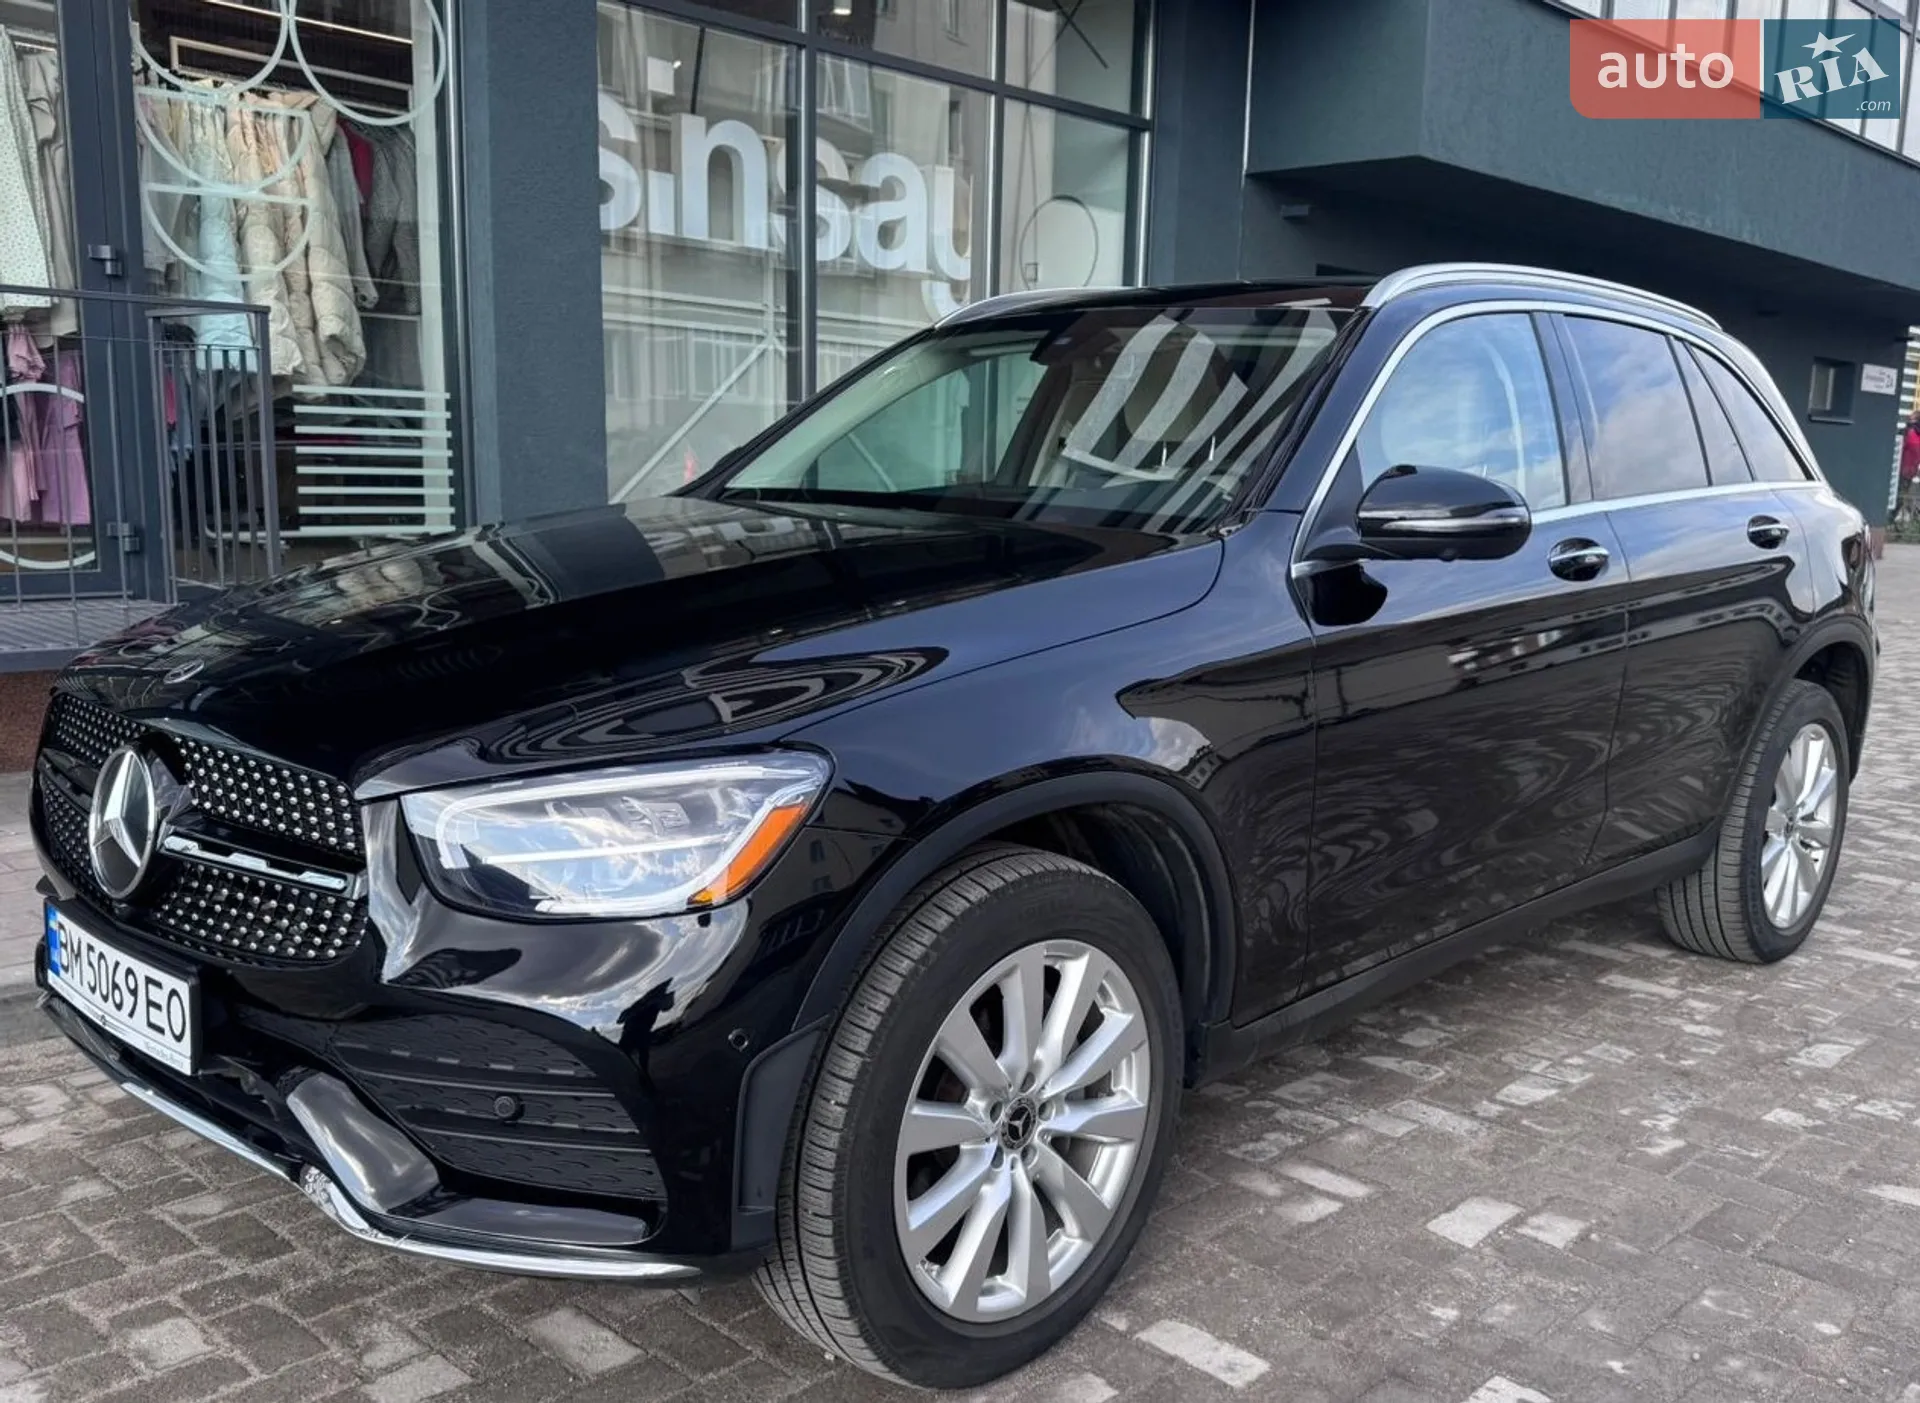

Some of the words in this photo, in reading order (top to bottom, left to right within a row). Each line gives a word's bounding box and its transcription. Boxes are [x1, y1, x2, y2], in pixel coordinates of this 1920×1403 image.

[57, 922, 83, 986] BM
[86, 944, 139, 1018] 5069
[144, 976, 187, 1042] EO
